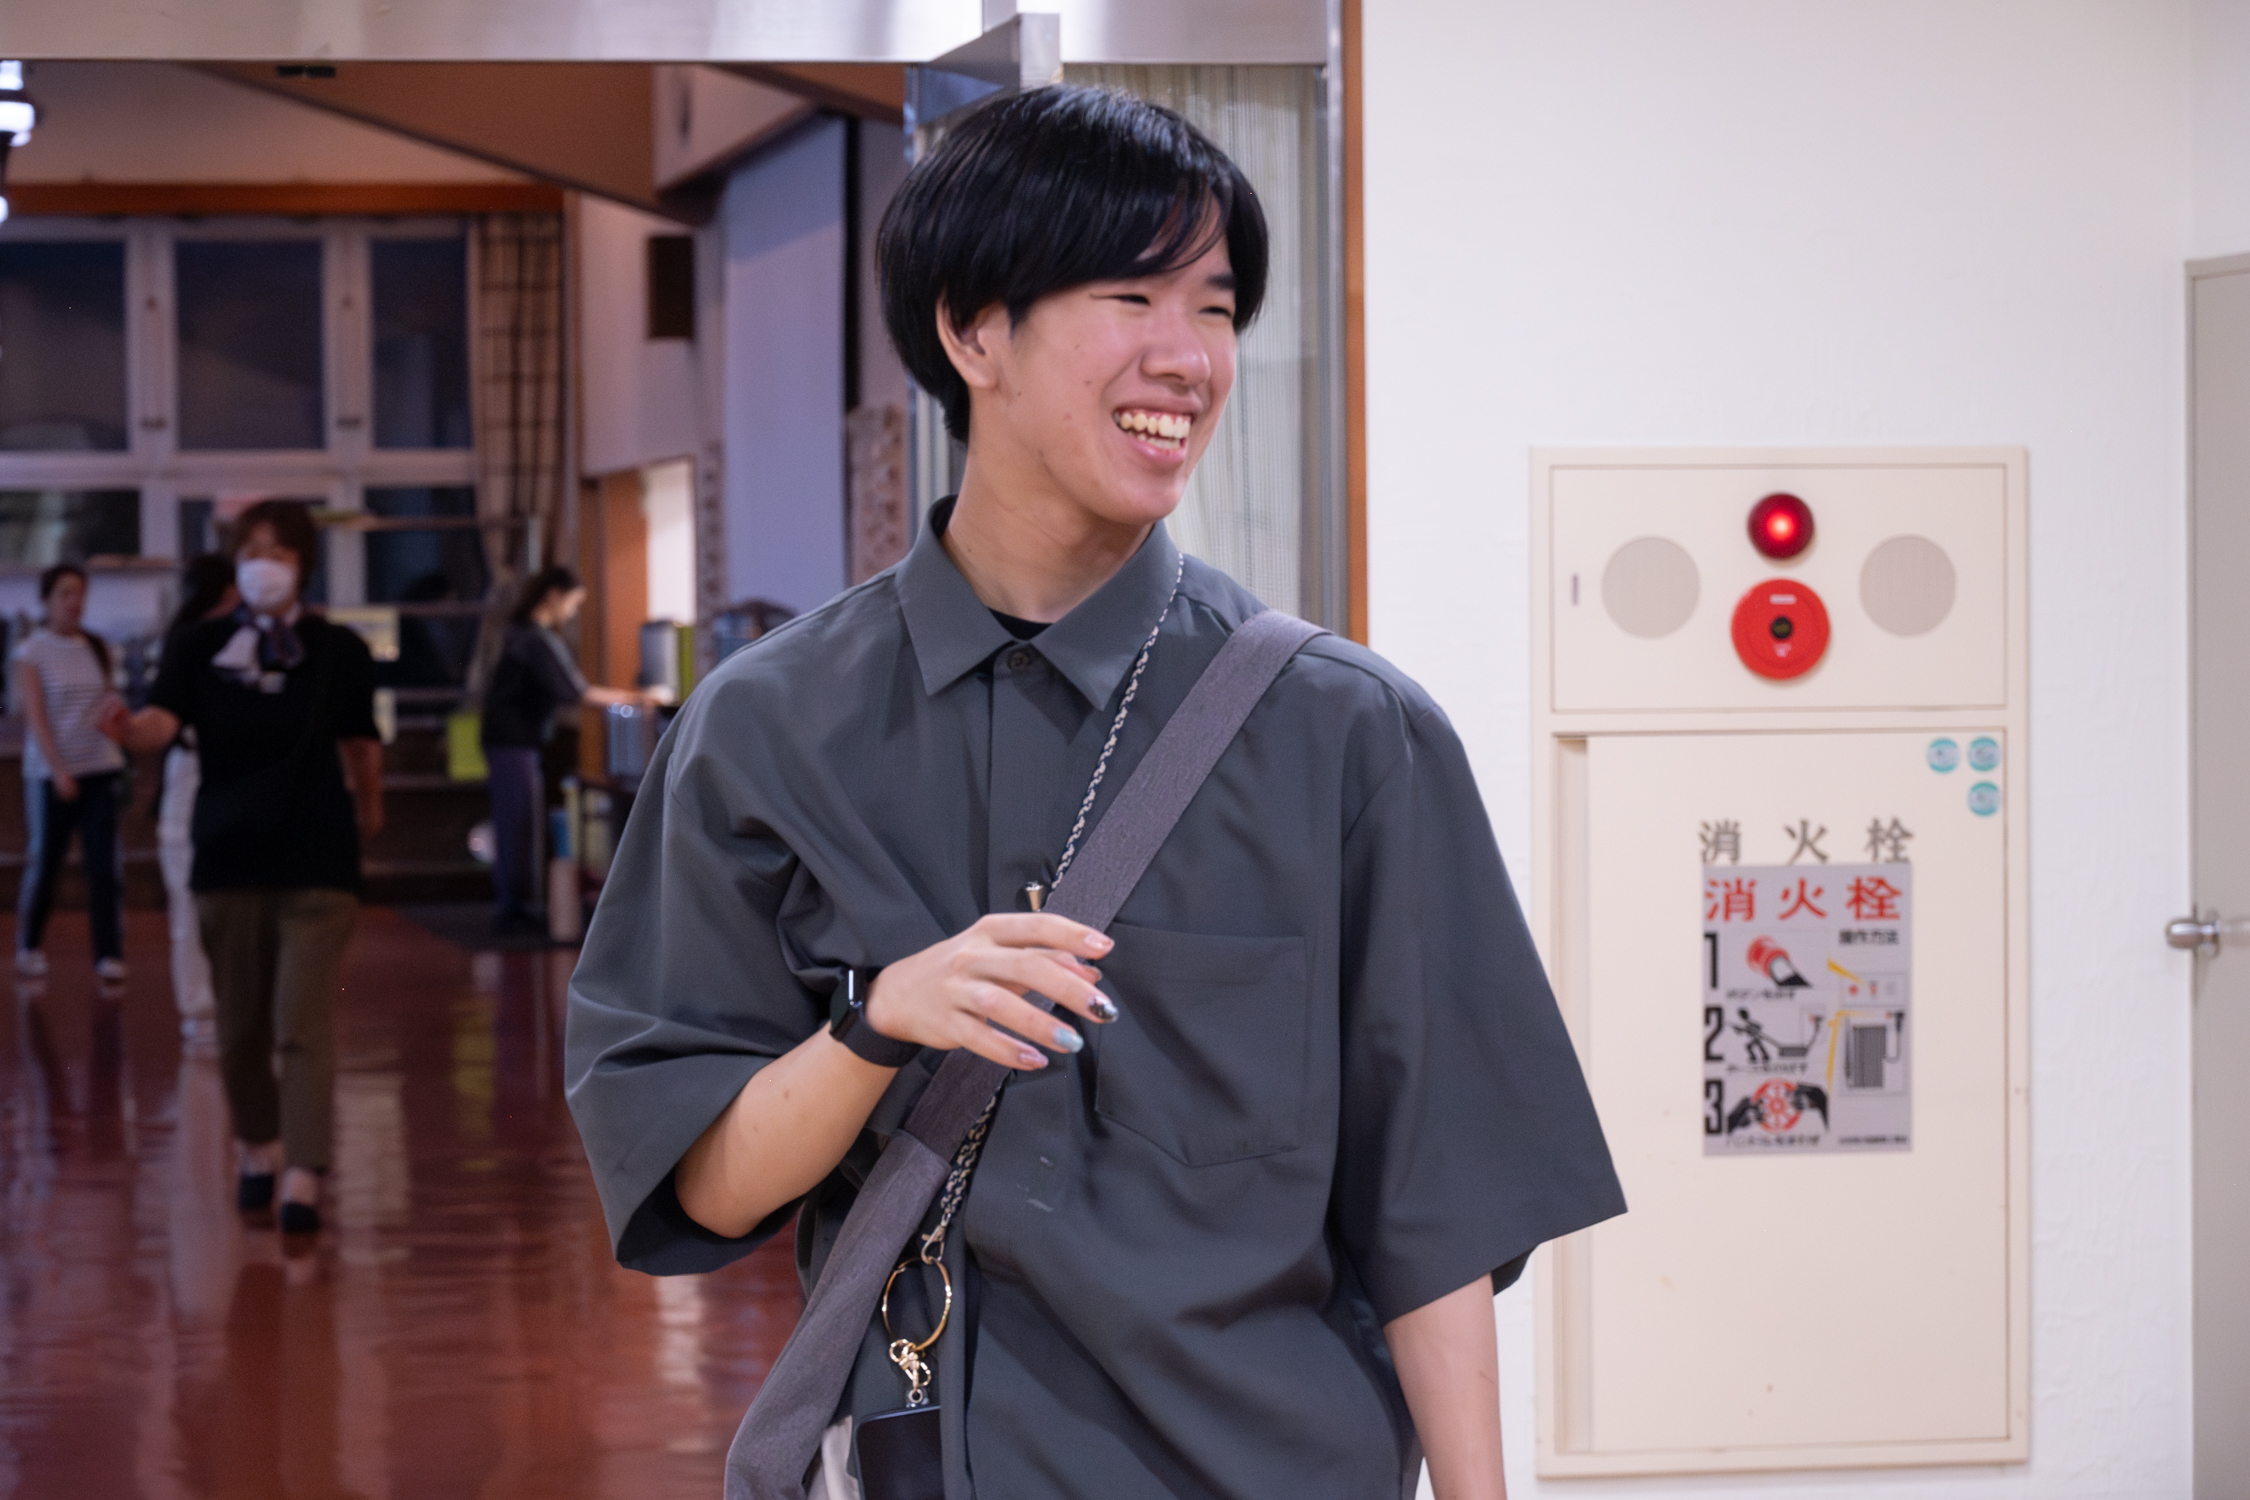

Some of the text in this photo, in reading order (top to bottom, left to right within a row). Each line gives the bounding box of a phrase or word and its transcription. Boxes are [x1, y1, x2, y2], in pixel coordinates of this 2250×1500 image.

[1699, 817, 1914, 864] 消火栓
[1705, 877, 1902, 922] 消火栓
[1703, 932, 1718, 989] 1
[1705, 1006, 1723, 1061] 2
[1705, 1080, 1722, 1134] 3
